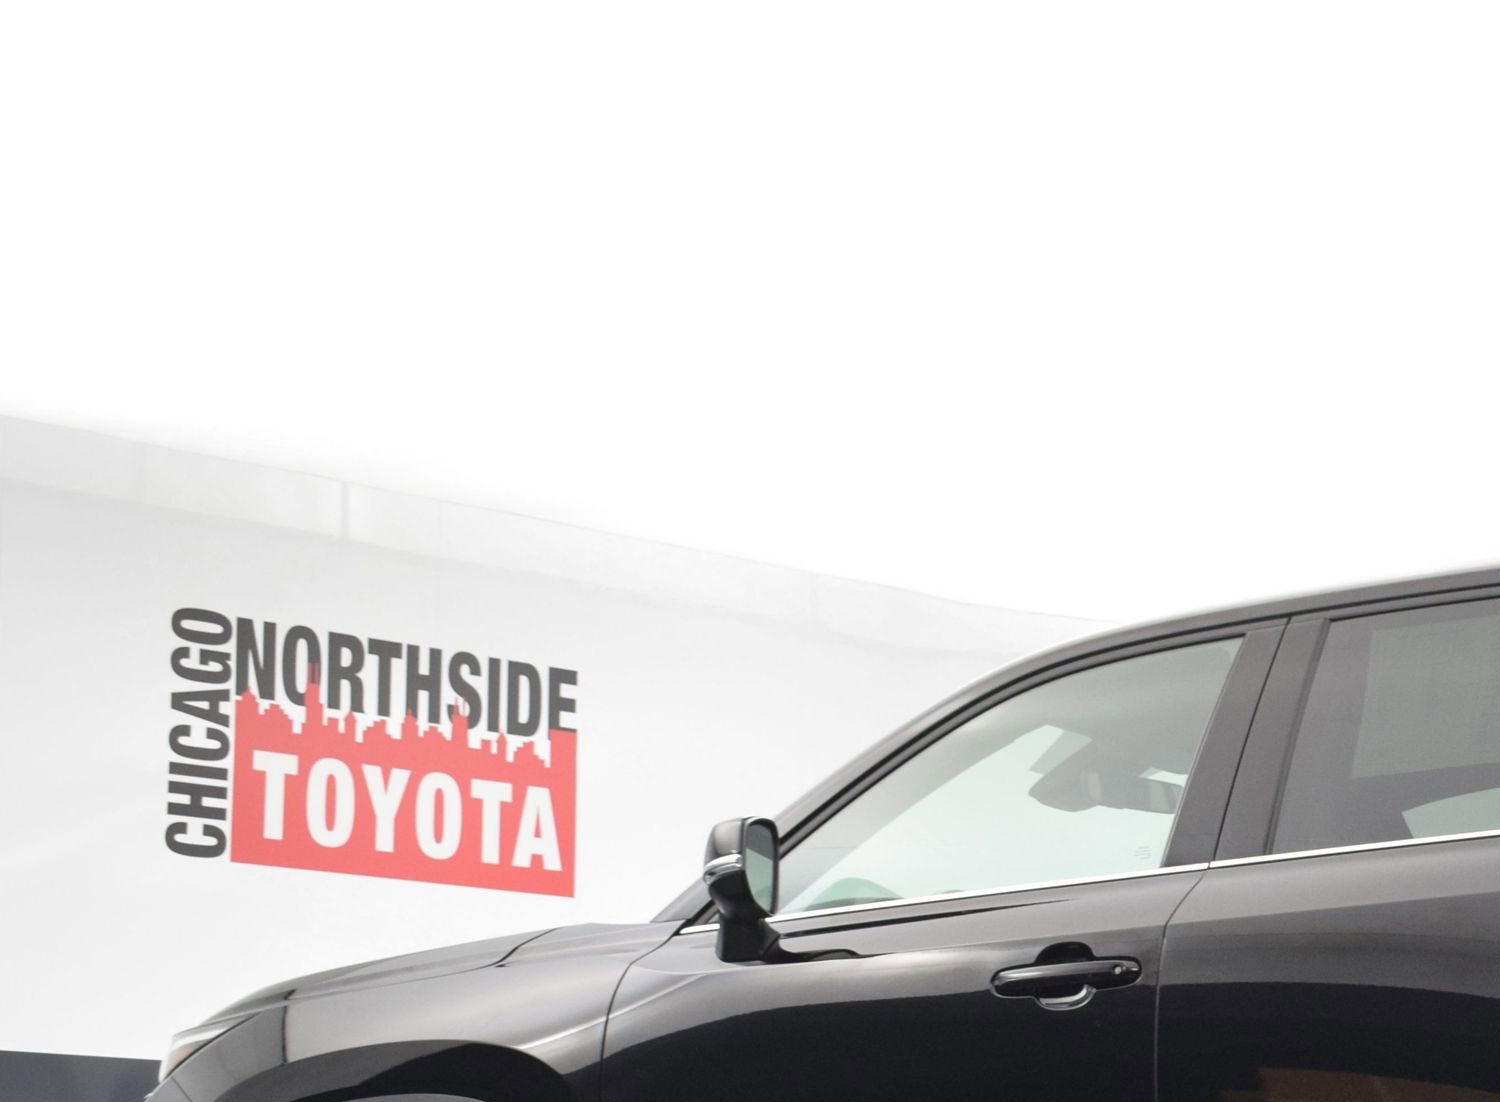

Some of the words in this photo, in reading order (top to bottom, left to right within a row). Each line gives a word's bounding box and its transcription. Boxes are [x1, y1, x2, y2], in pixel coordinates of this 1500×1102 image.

[165, 607, 233, 859] CHICAGO
[235, 616, 578, 738] NORTHSIDE
[252, 749, 563, 872] TOYOTA
